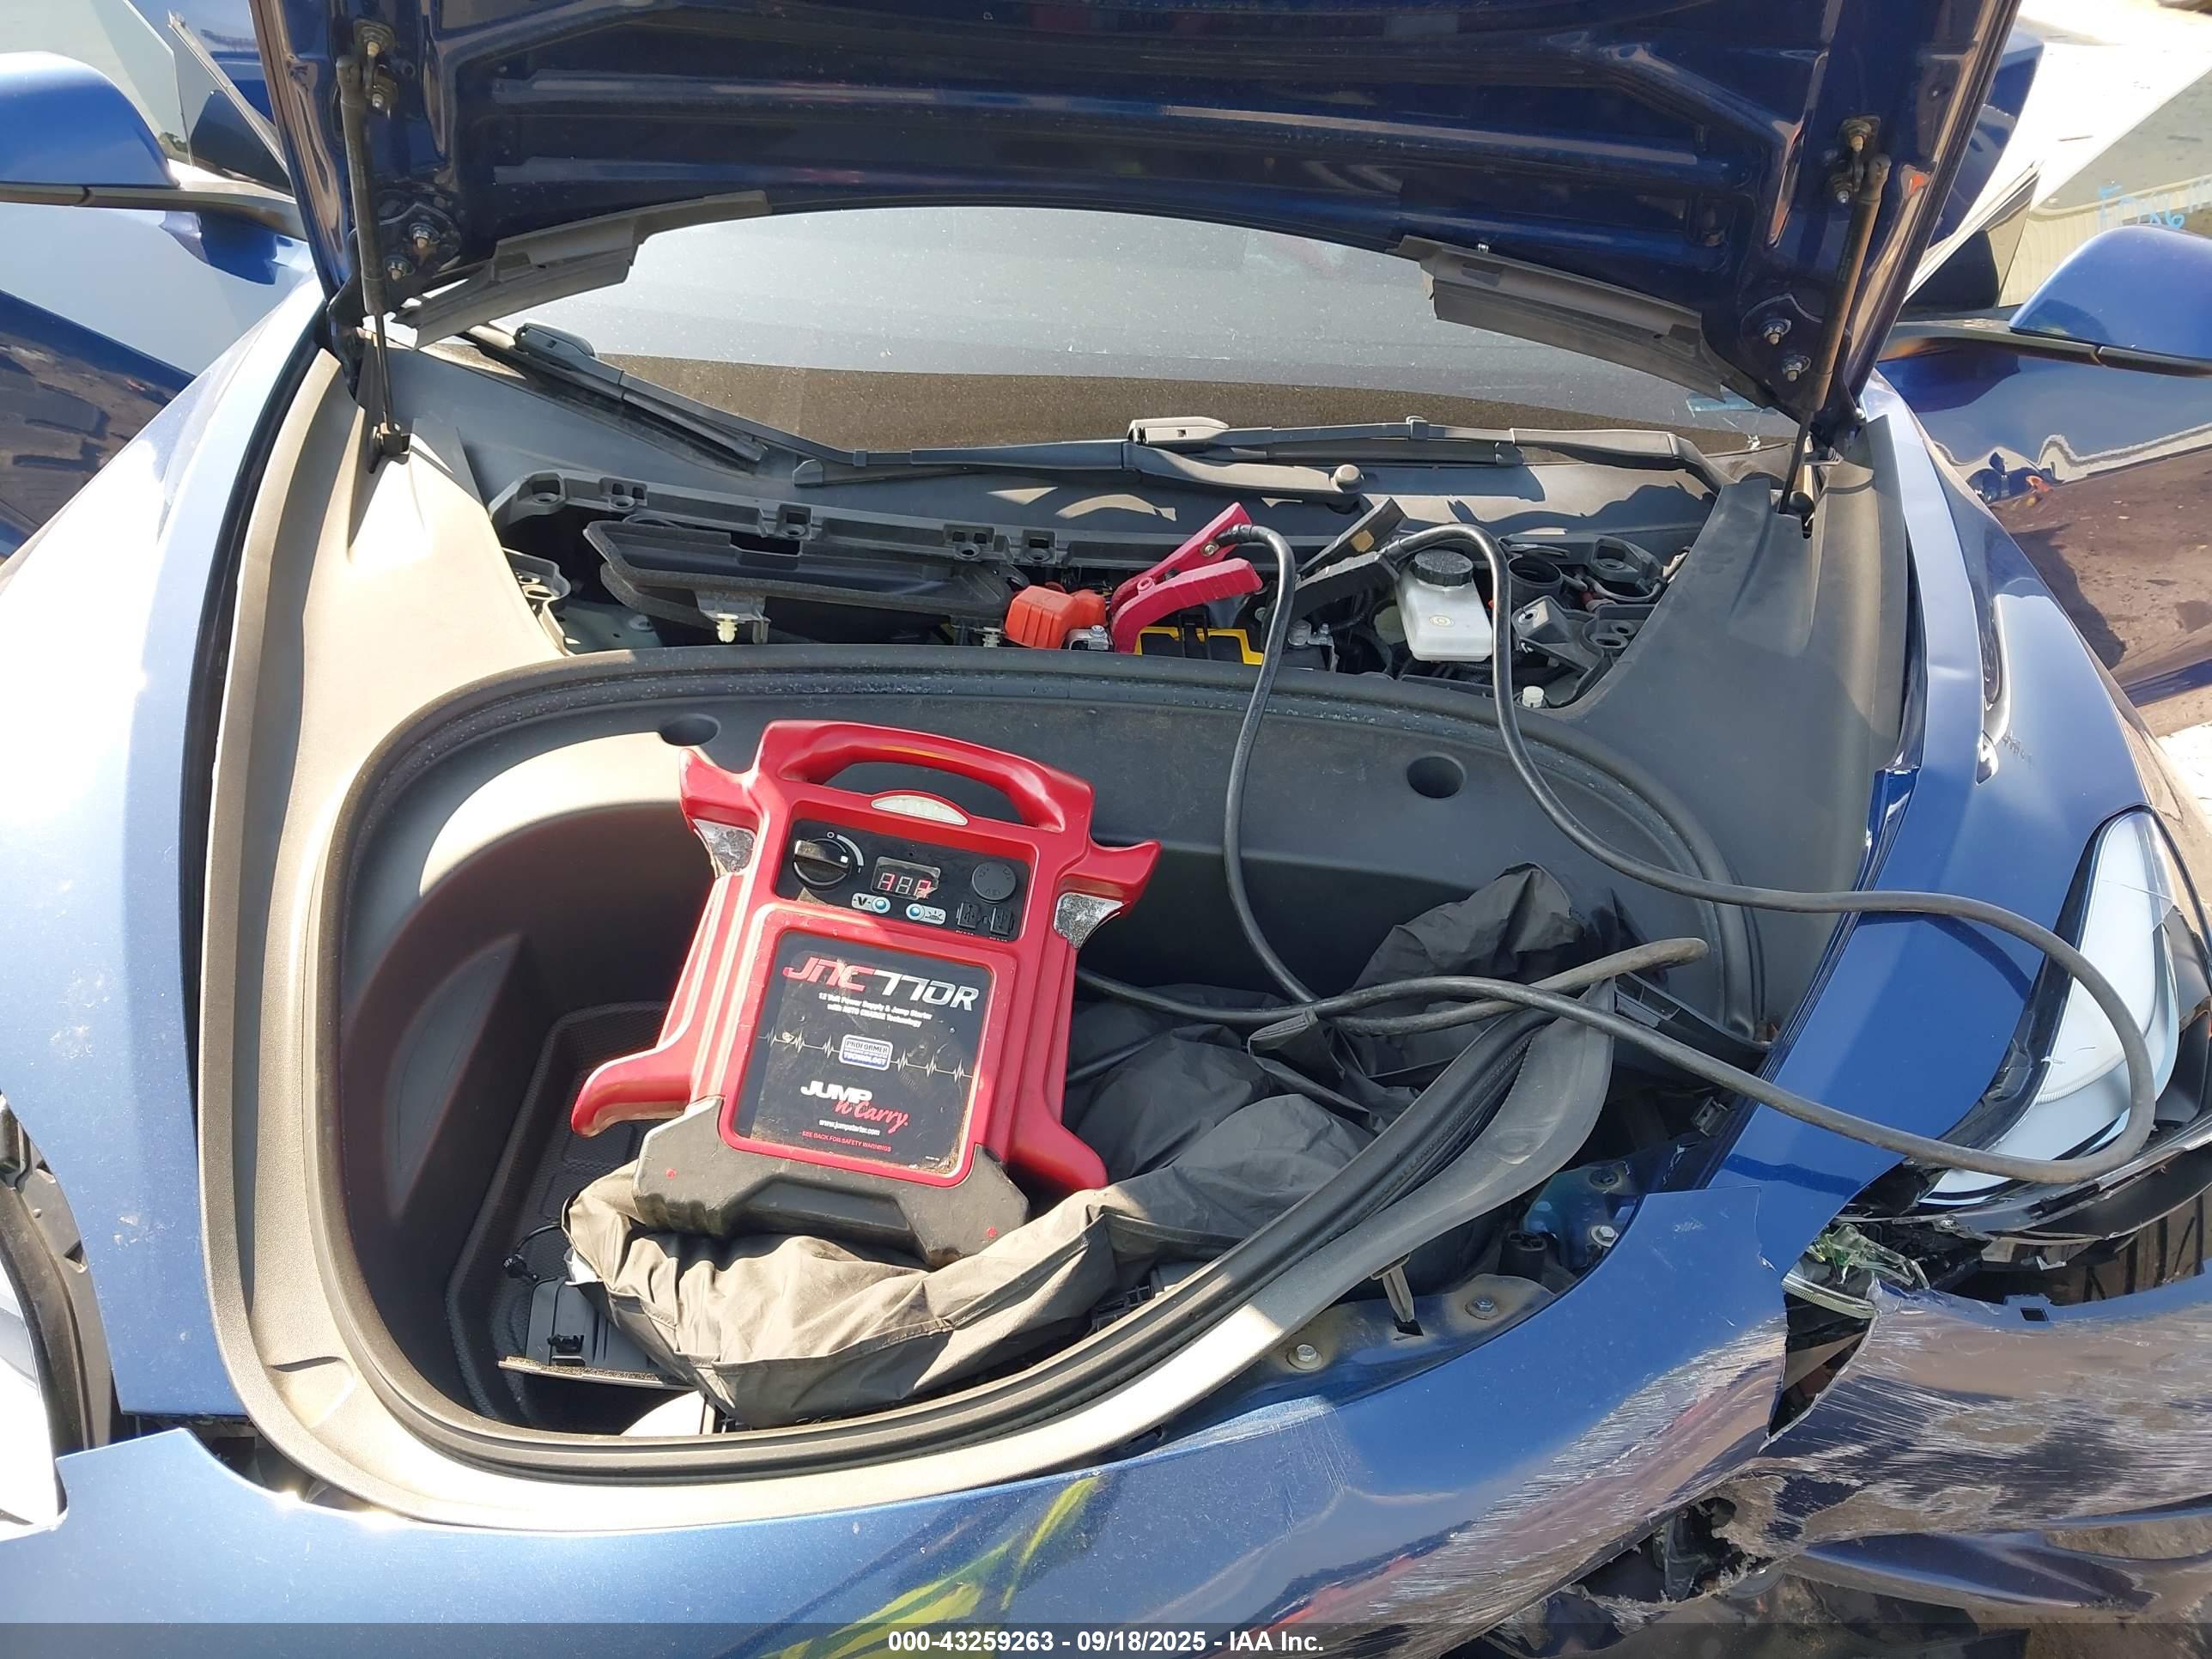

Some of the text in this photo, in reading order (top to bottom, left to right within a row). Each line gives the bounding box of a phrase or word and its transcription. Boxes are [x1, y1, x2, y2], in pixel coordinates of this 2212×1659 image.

[782, 957, 980, 1012] JNC770R
[846, 1040, 888, 1054] PROFORMER
[800, 1080, 872, 1103] JUMP
[841, 1138, 863, 1147] SAFETY
